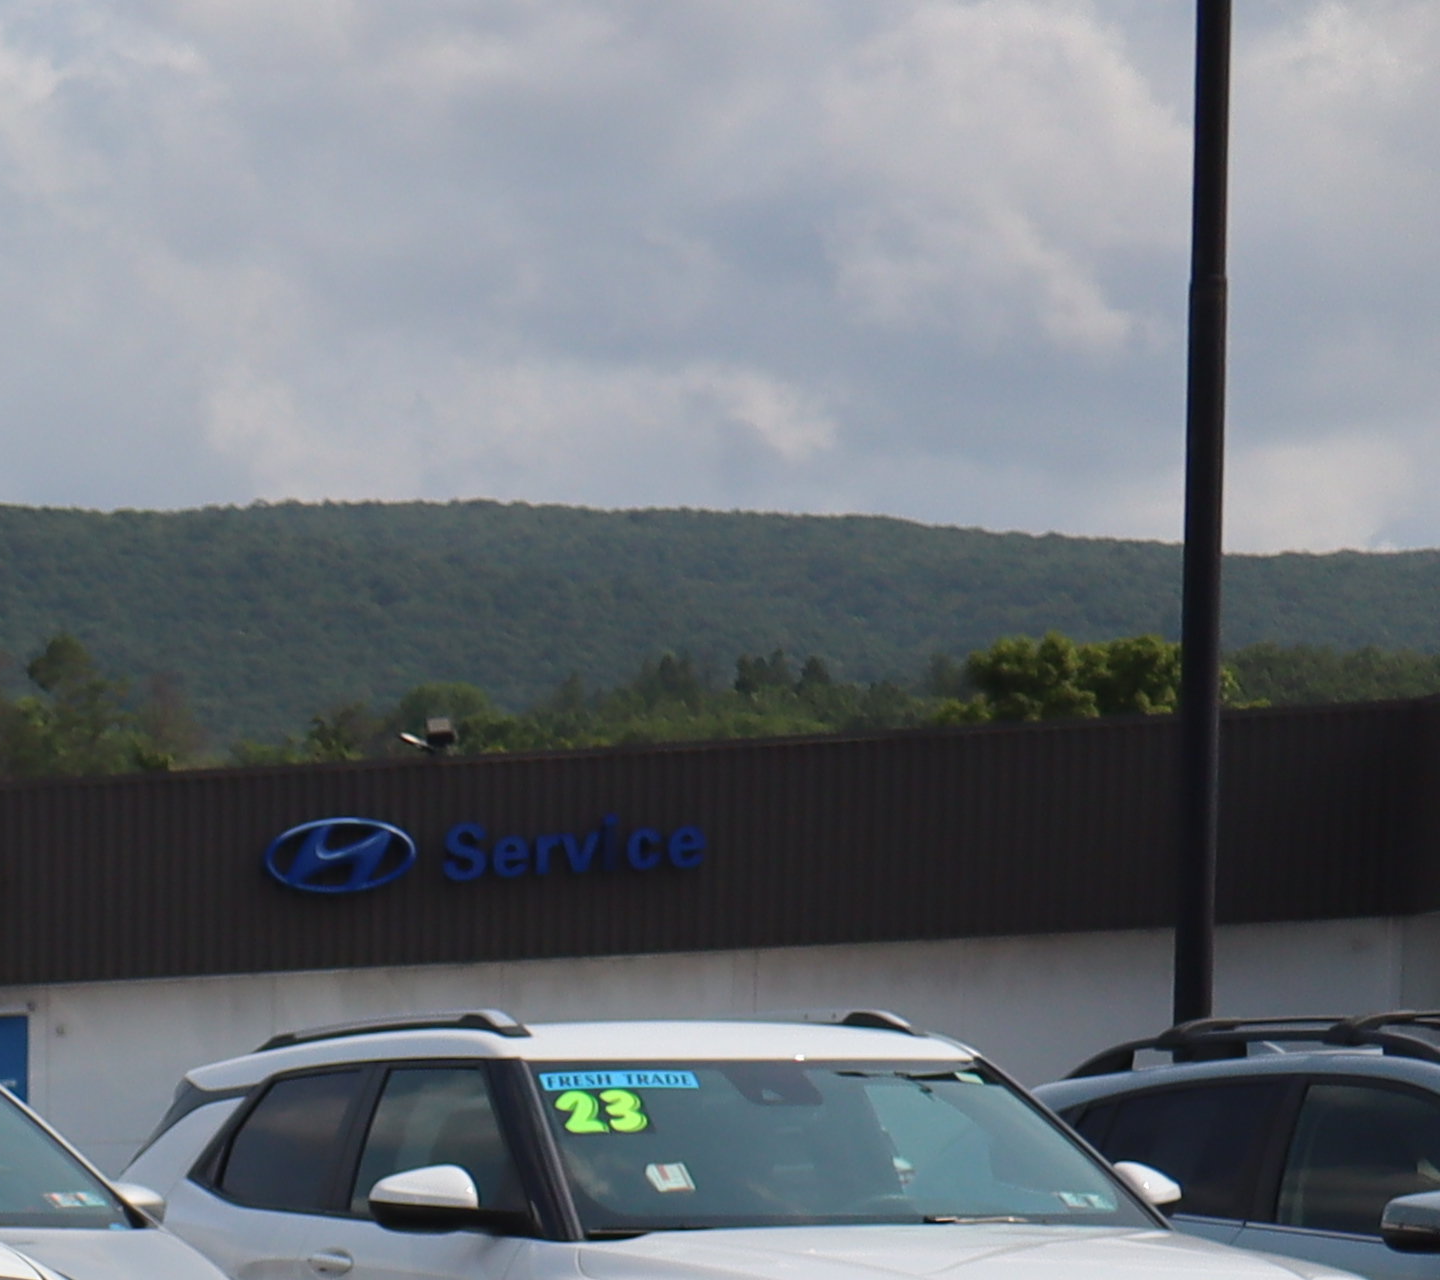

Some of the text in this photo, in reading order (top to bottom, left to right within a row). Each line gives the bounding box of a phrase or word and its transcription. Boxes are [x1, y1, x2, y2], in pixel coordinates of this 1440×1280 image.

[443, 812, 707, 882] Service
[546, 1072, 693, 1089] FRESH TRADE
[555, 1089, 648, 1133] 23
